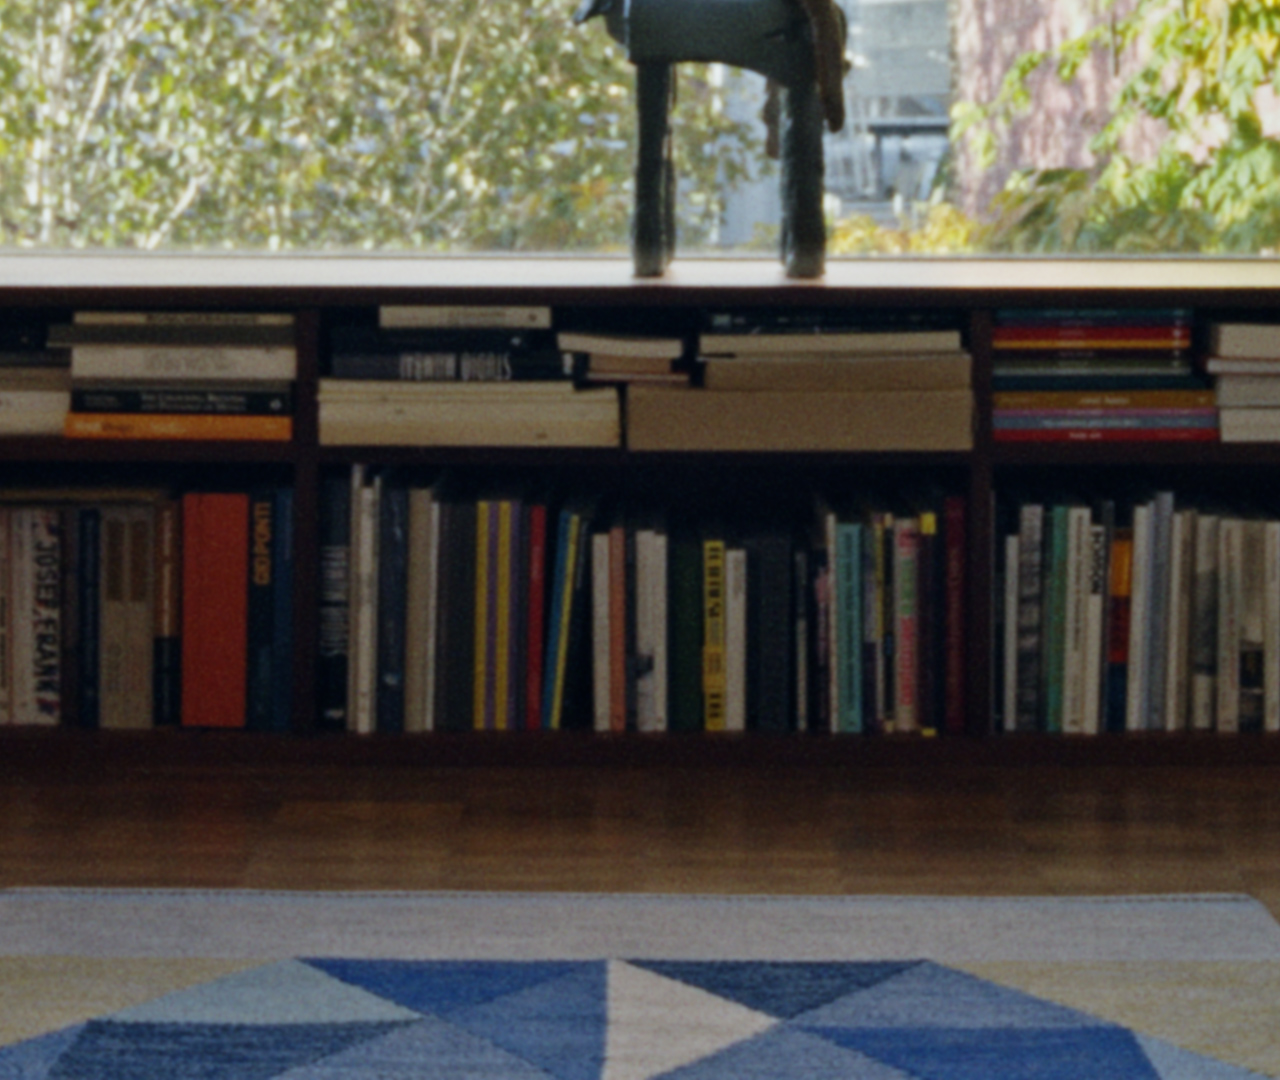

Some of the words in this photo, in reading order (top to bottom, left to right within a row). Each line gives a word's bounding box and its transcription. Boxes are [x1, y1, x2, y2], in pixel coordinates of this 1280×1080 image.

[253, 501, 272, 555] PONTI
[36, 539, 60, 609] JOSEF
[253, 556, 272, 585] GIO
[33, 615, 59, 694] FRANK
